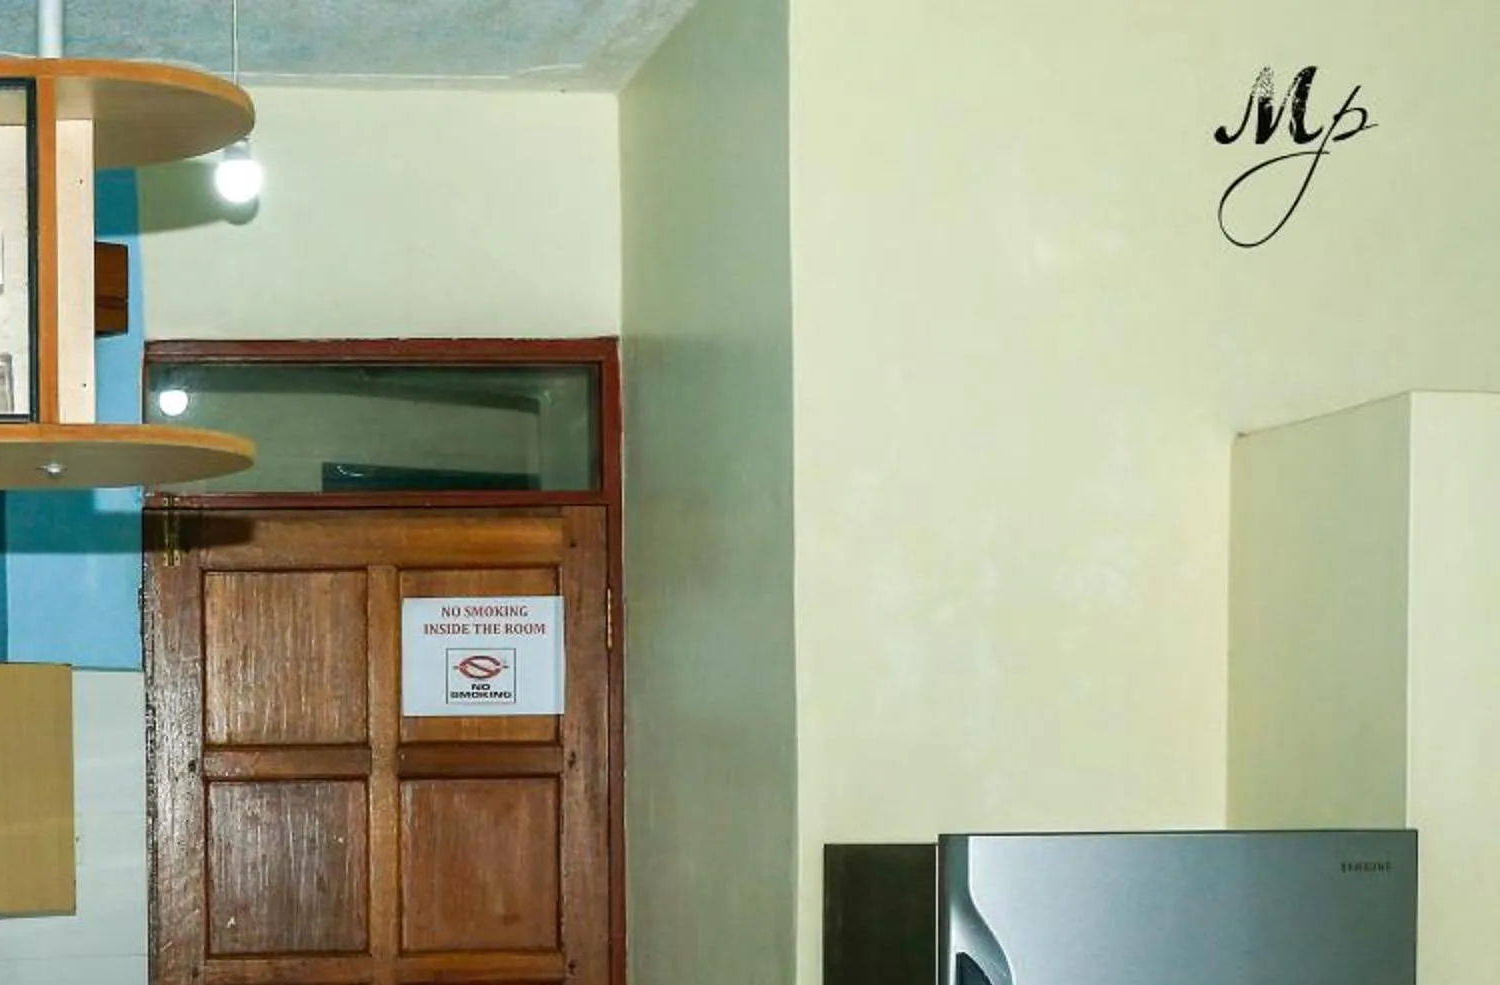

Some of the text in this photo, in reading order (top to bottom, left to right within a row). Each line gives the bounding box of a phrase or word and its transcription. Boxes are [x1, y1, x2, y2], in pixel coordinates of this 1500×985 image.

[441, 605, 529, 617] NO SMOKING
[424, 623, 546, 635] INSIDE THE ROOM
[471, 683, 491, 691] NO
[450, 691, 512, 699] SMOKING
